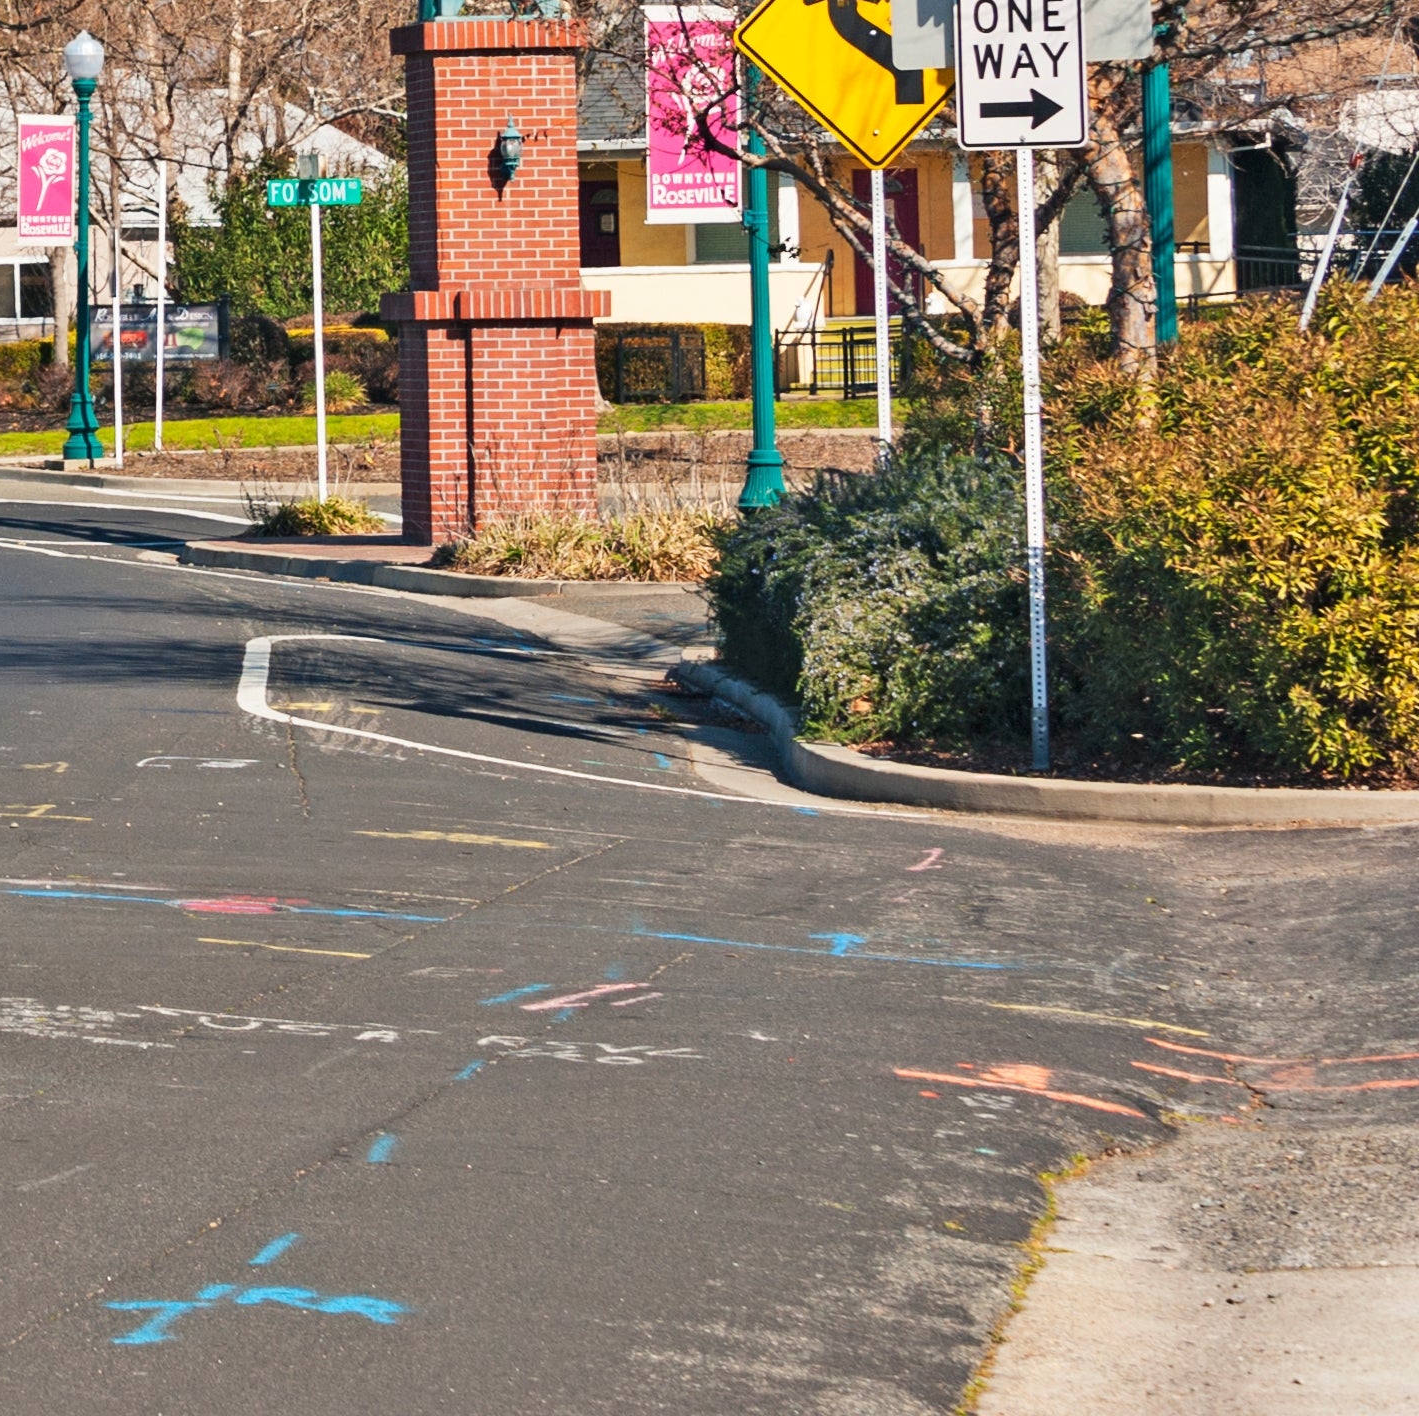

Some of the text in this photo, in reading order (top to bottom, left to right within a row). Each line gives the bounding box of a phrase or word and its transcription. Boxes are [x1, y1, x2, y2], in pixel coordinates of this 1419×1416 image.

[973, 41, 1069, 79] WAY
[22, 128, 71, 152] Welcome!
[652, 173, 735, 183] DOWNTOWN
[652, 185, 735, 205] ROSEVILLE
[21, 215, 71, 223] DOWNTOWN
[21, 223, 70, 235] ROSEVILLE
